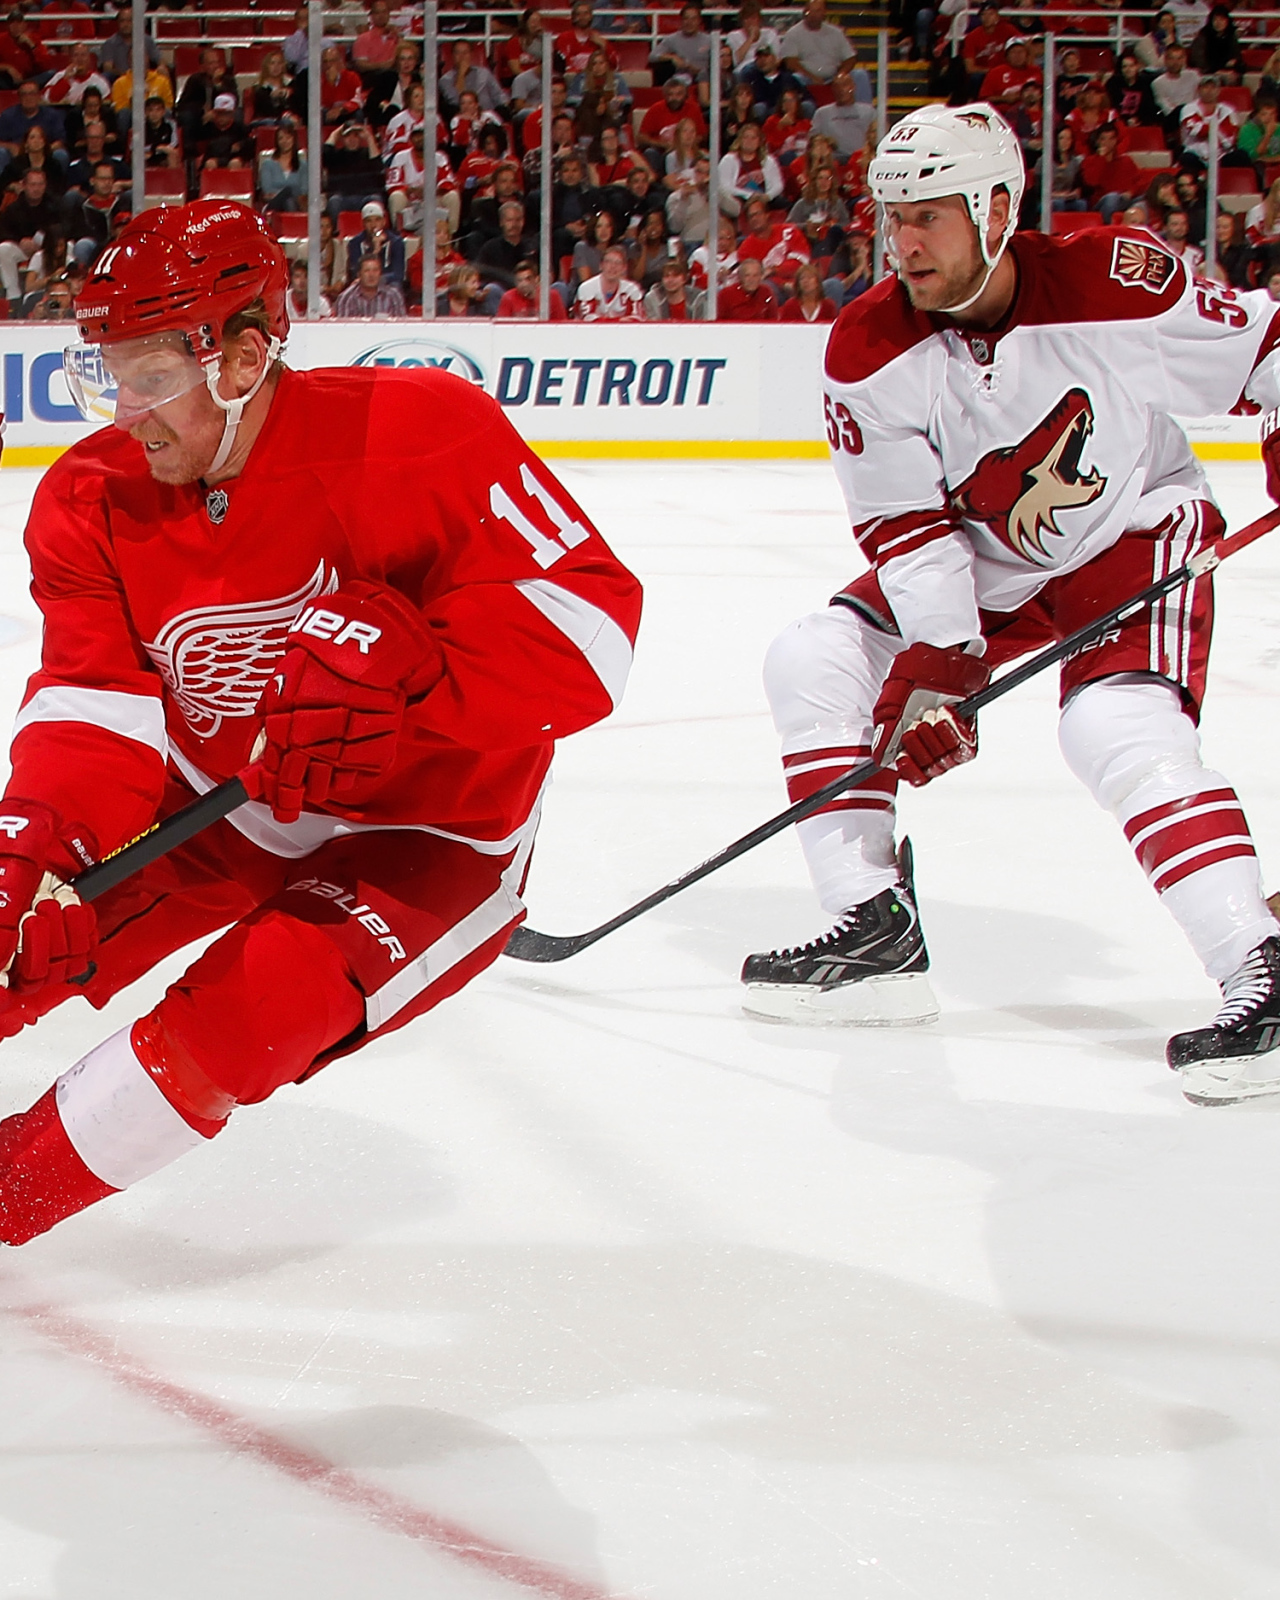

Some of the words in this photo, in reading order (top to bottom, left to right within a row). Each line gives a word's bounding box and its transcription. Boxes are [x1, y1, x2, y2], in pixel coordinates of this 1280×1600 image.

[890, 127, 920, 142] 53
[875, 172, 910, 181] CCM
[186, 218, 210, 235] Red
[208, 209, 242, 225] Wings
[94, 246, 121, 276] 11
[1146, 250, 1164, 284] PHX
[75, 305, 110, 319] BAUER
[499, 357, 727, 407] DETROIT
[489, 462, 591, 571] 11
[101, 822, 160, 863] EASTON
[286, 876, 407, 964] BAUER
